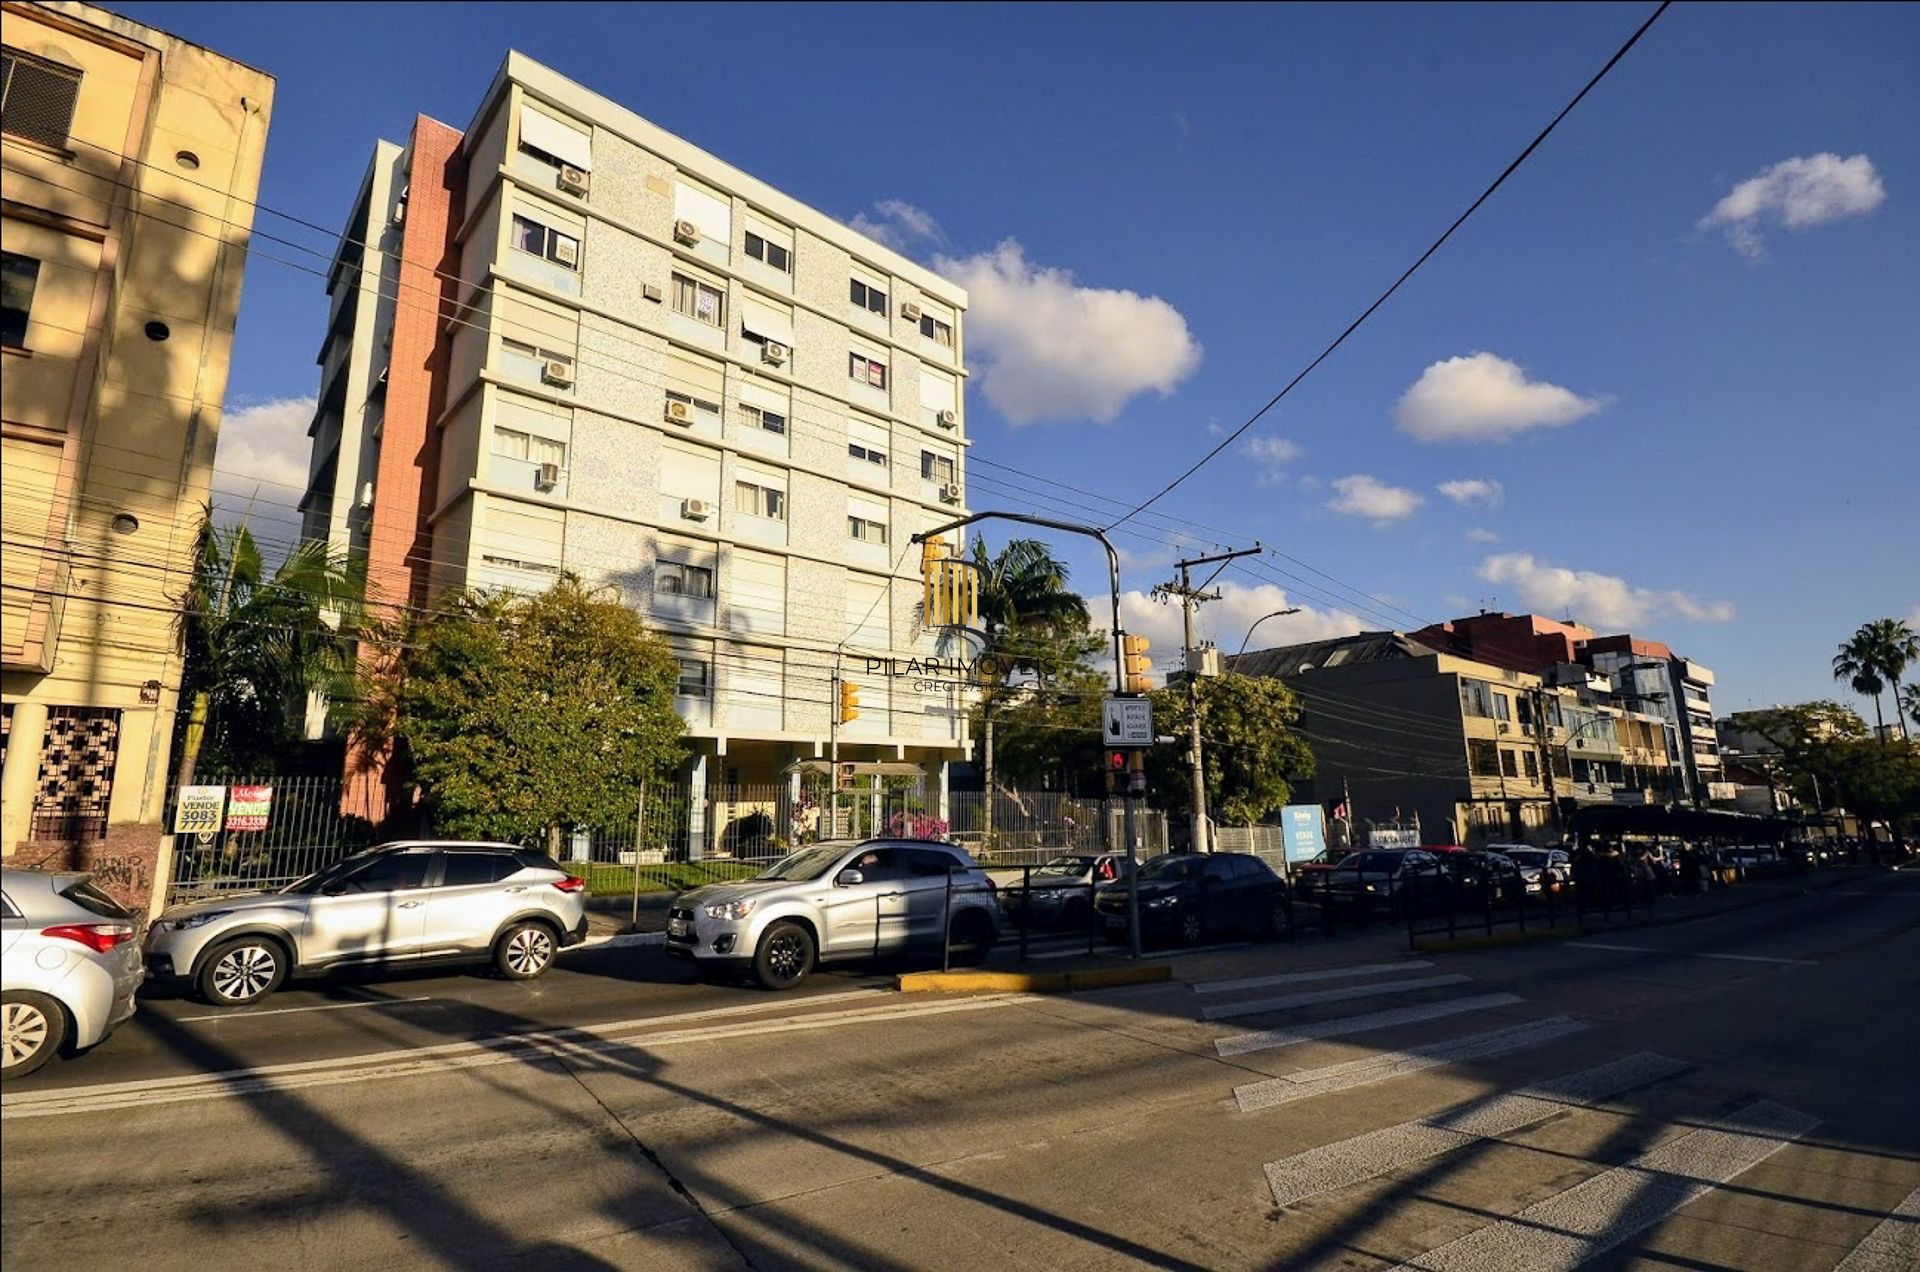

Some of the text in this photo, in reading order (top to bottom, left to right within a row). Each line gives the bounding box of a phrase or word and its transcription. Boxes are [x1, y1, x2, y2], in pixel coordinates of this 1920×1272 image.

[183, 801, 220, 809] VENDE
[228, 803, 269, 815] VENDE
[181, 810, 217, 820] 3083
[180, 820, 217, 830] 7777
